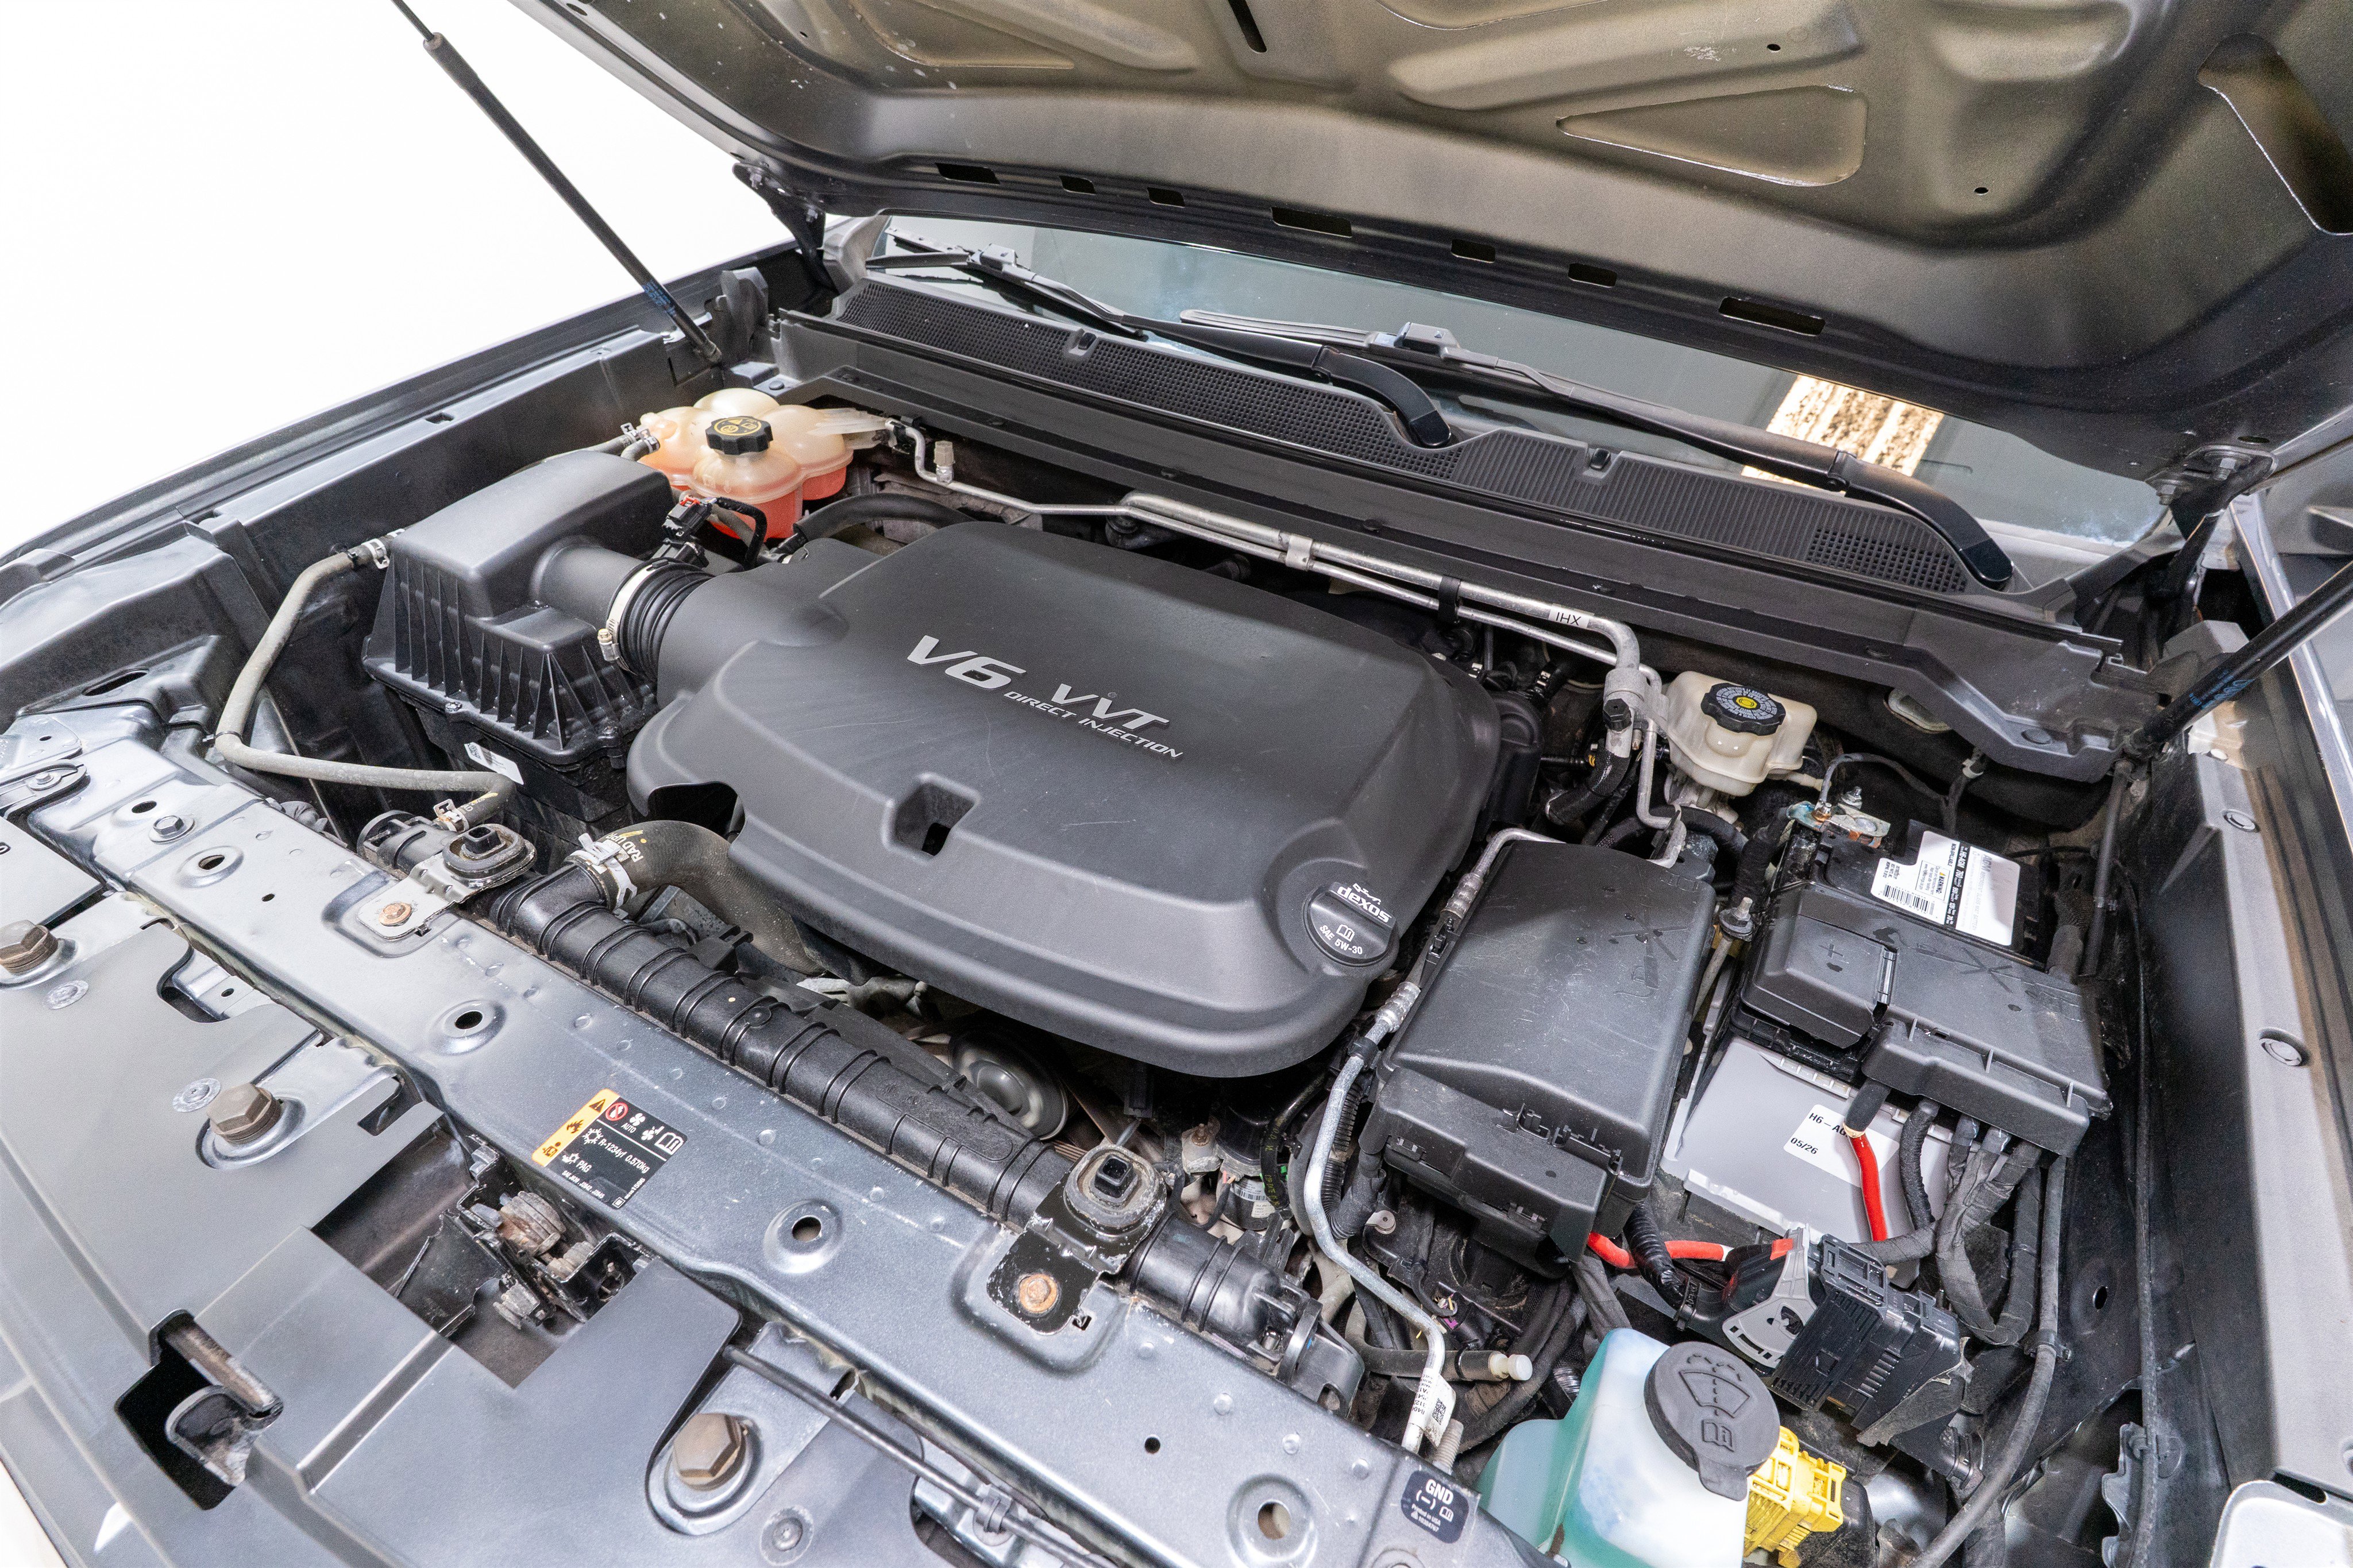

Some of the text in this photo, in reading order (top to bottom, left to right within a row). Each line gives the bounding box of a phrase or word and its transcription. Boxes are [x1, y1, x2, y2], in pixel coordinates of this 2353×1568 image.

[1556, 612, 1581, 625] IHX
[907, 634, 1170, 732] V6 VVT
[1003, 689, 1183, 759] DIRECT INJECTION
[622, 841, 645, 862] RAD
[1981, 853, 1992, 872] AGM
[1954, 868, 1964, 879] 760
[1337, 886, 1390, 923] dexos
[1319, 925, 1363, 955] SAE 5W-30
[622, 1122, 637, 1133] AUTO
[1831, 1125, 1849, 1137] AG
[598, 1138, 651, 1174] R-1234yf 0.570kg
[1789, 1137, 1818, 1155] 05/26
[576, 1160, 592, 1173] PAG
[1426, 1479, 1453, 1505] GND
